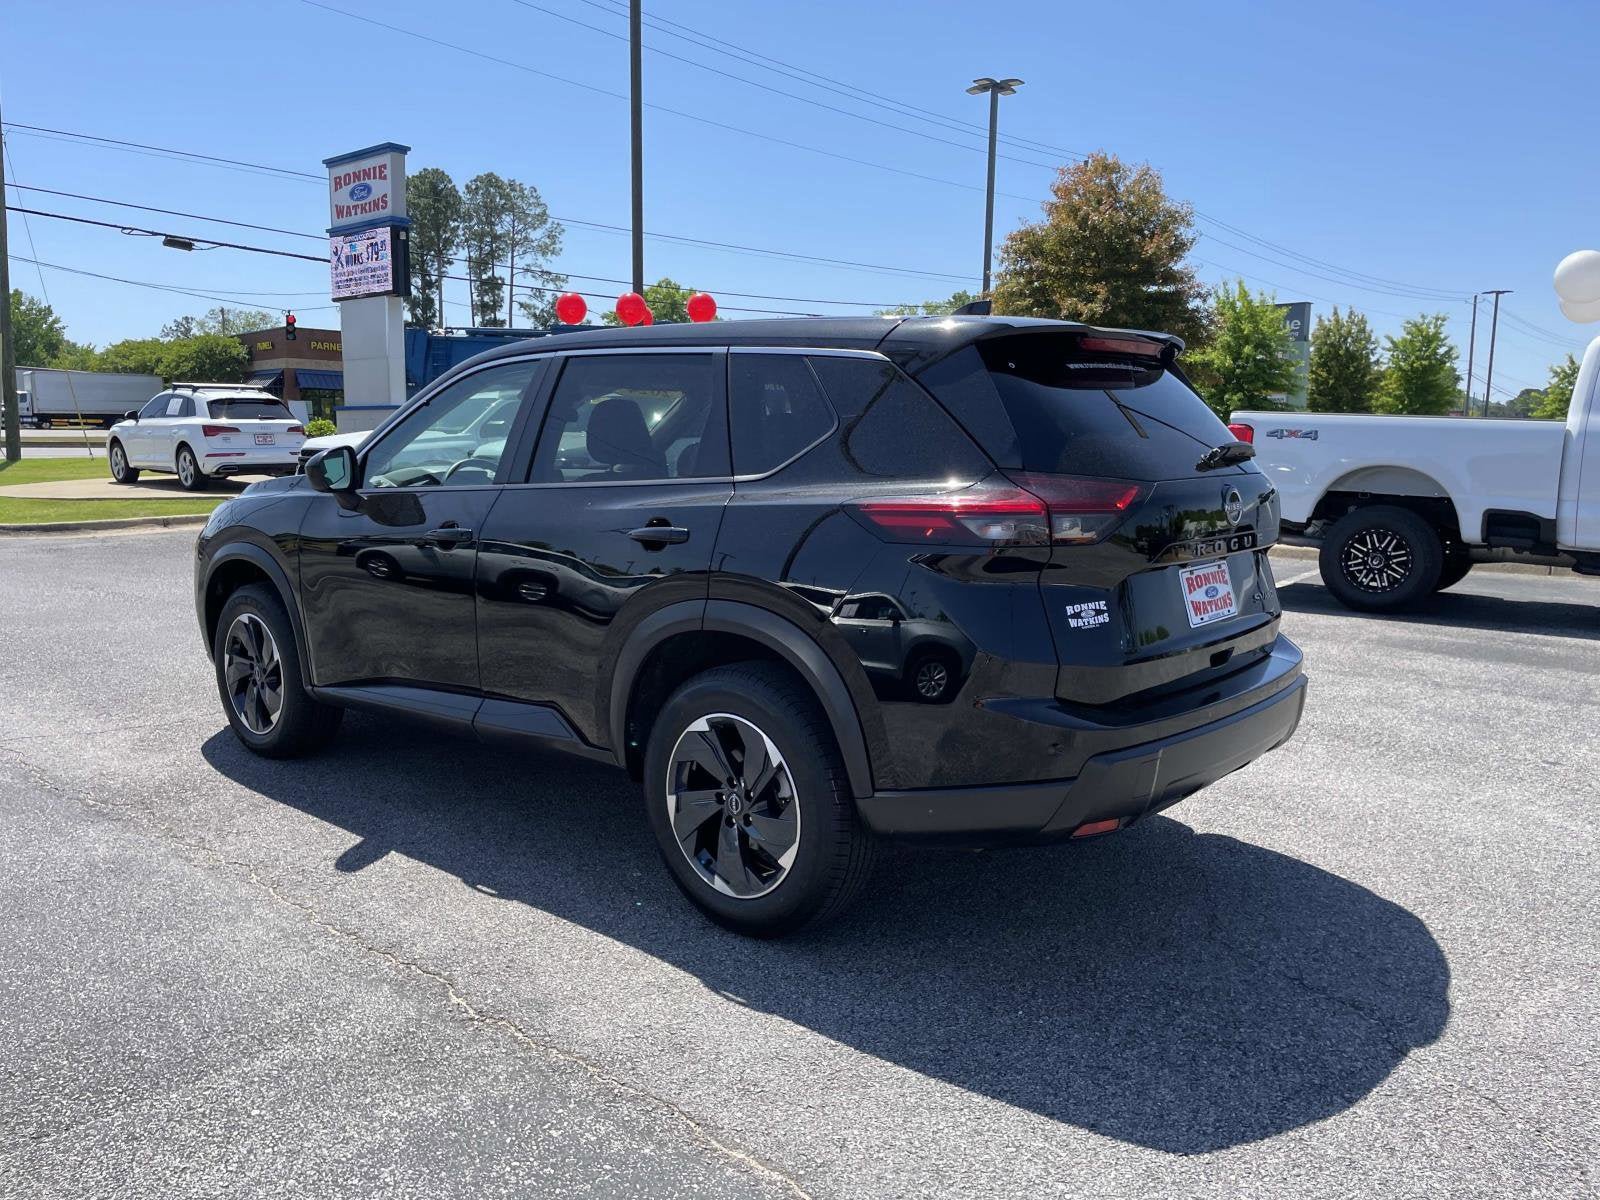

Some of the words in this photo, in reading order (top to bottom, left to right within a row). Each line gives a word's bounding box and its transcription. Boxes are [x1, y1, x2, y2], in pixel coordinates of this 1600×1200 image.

[333, 163, 388, 192] RONNIE
[335, 193, 388, 219] WATKINS
[1185, 569, 1229, 595] RONNIE
[1066, 601, 1107, 616] RONNIE
[1190, 591, 1233, 617] WATKINS
[1068, 613, 1110, 628] WATKINS
